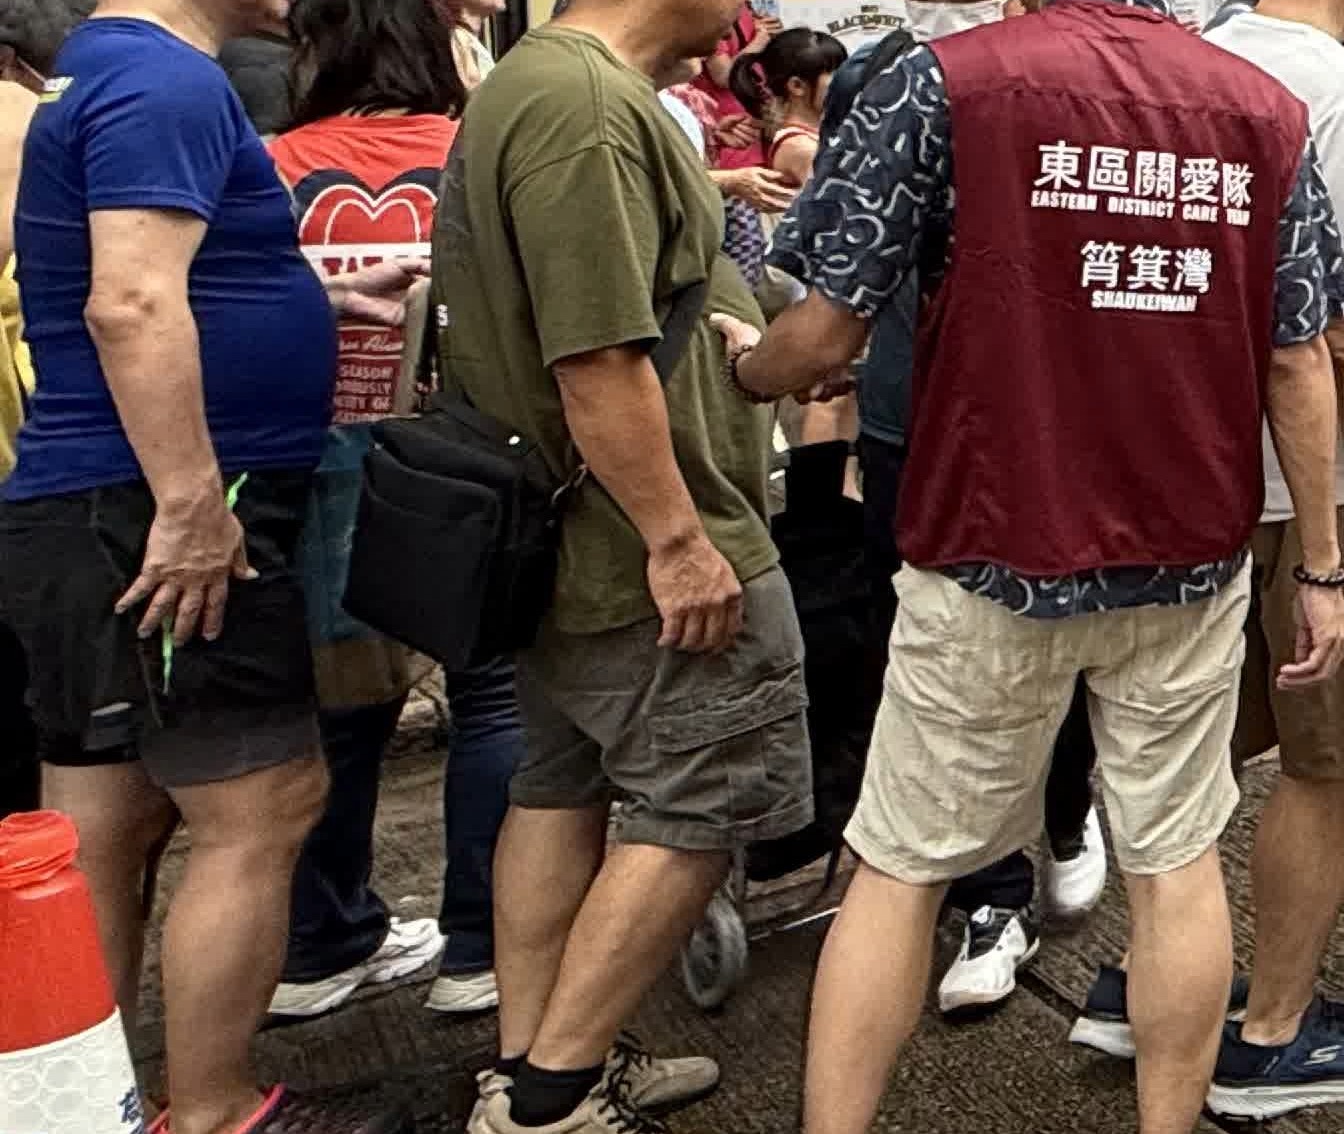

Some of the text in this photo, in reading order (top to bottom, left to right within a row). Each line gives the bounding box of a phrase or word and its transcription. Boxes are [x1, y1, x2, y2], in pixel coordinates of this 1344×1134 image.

[1033, 140, 1255, 209] 東區關愛隊
[1031, 189, 1098, 212] EASTERN
[1107, 197, 1175, 219] DISTRICT
[1182, 204, 1218, 222] CARE
[1080, 240, 1213, 294] 筲箕灣
